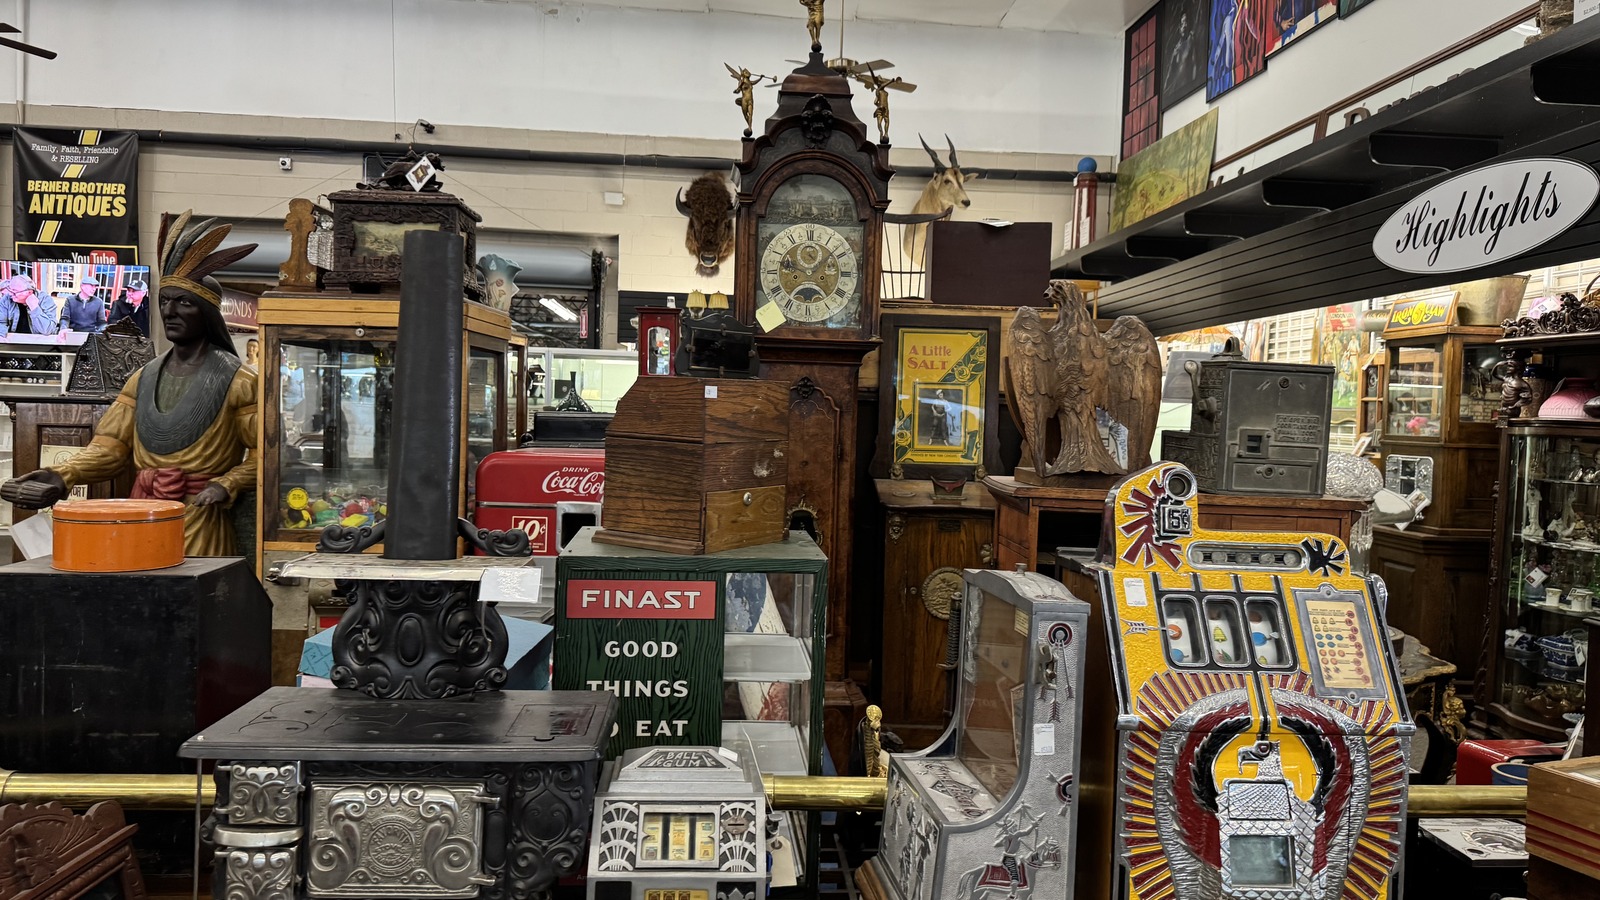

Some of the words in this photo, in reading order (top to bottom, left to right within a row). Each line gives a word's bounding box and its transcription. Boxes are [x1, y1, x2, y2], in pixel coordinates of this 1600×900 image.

[31, 143, 59, 153] Family,
[60, 145, 82, 154] Faith,
[83, 146, 119, 156] Friendship
[51, 155, 59, 163] &
[60, 155, 100, 164] RESELLING
[27, 179, 70, 193] BERNER
[70, 181, 127, 195] BROTHER
[28, 193, 127, 219] ANTIQUES
[1395, 170, 1562, 267] Highlights
[71, 251, 116, 265] YouTube
[908, 344, 919, 356] A
[921, 345, 952, 357] Little
[906, 357, 949, 371] SALT
[581, 589, 701, 609] FINAST
[604, 640, 678, 658] GOOD
[586, 680, 689, 698] THINGS
[635, 720, 689, 737] EAT
[663, 759, 701, 767] GUM
[666, 751, 700, 760] BALL
